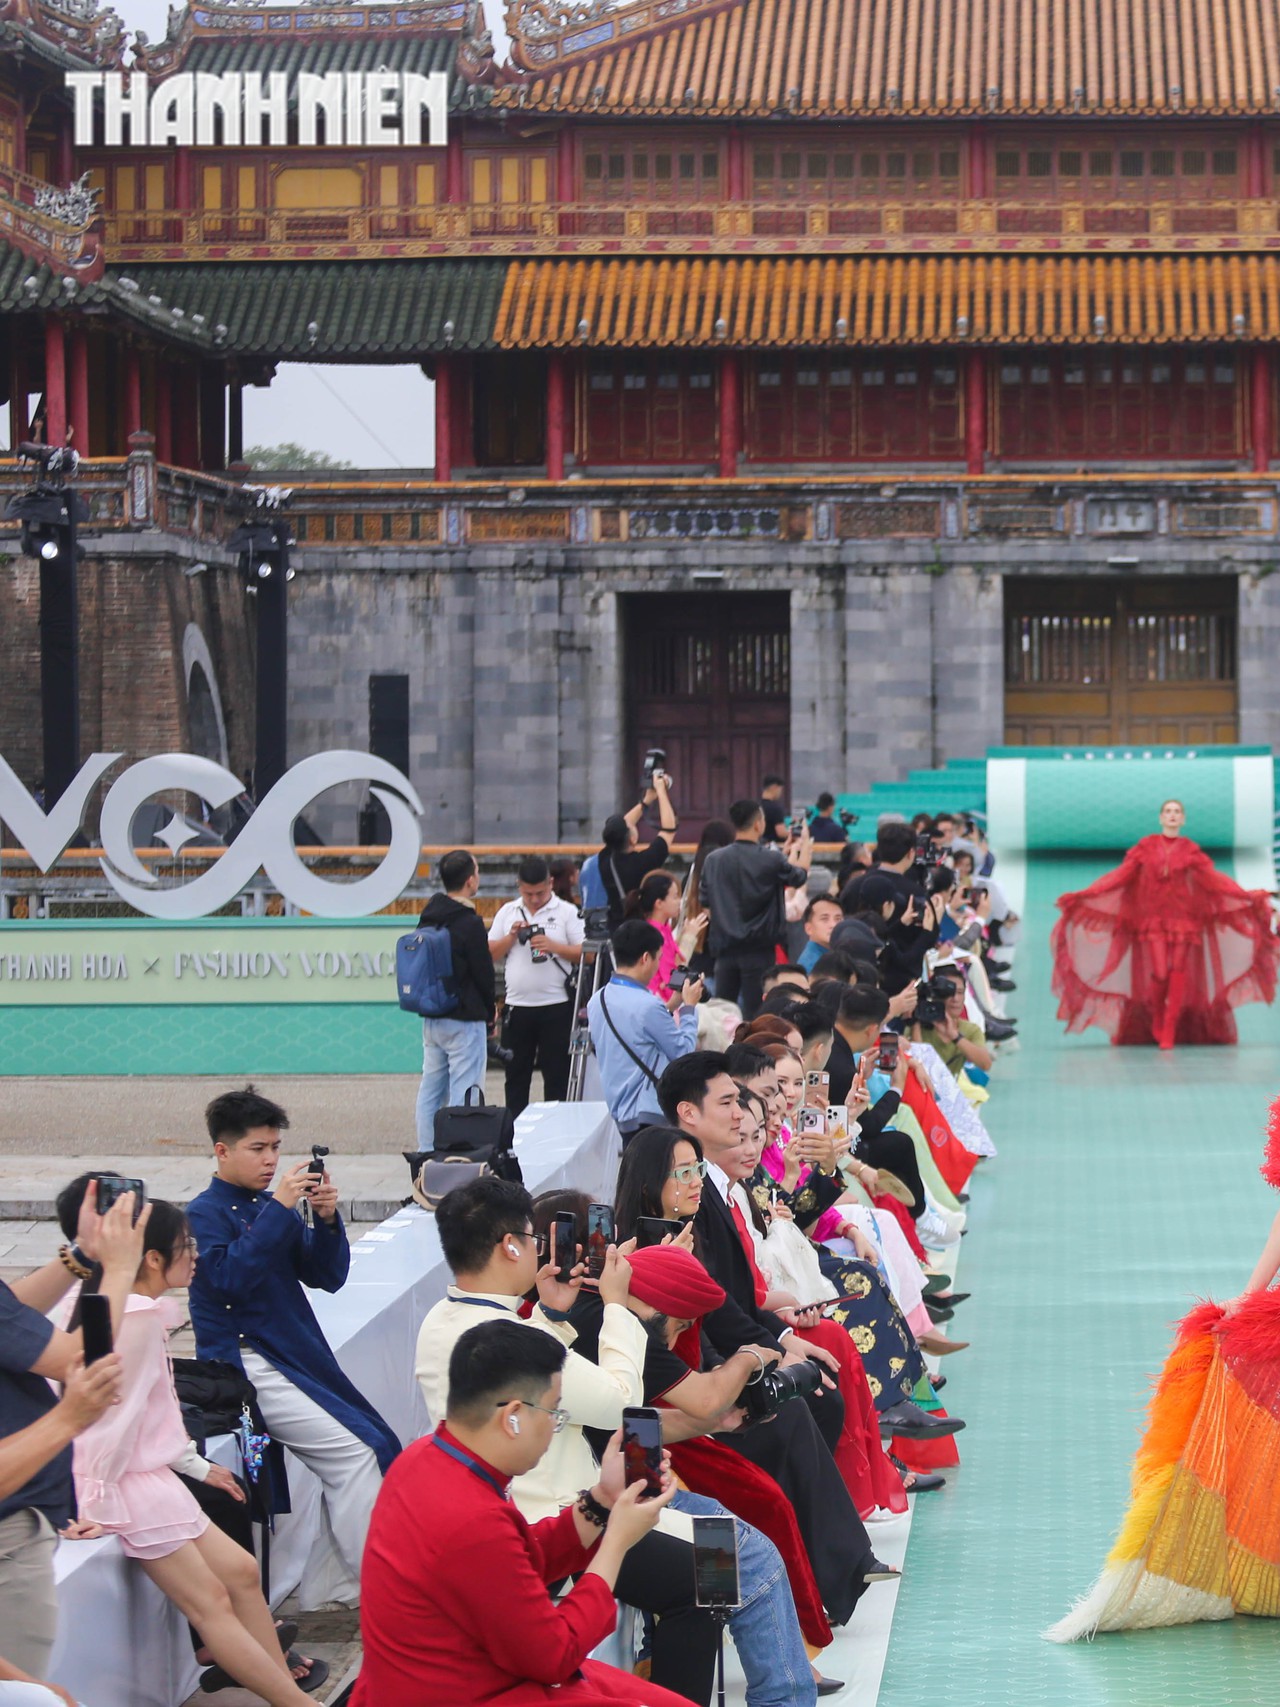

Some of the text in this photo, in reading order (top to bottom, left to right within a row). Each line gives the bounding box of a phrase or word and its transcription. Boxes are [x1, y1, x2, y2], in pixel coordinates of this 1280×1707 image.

[82, 951, 128, 980] HOA
[174, 950, 290, 980] FASHION
[299, 949, 397, 979] VOYAG
